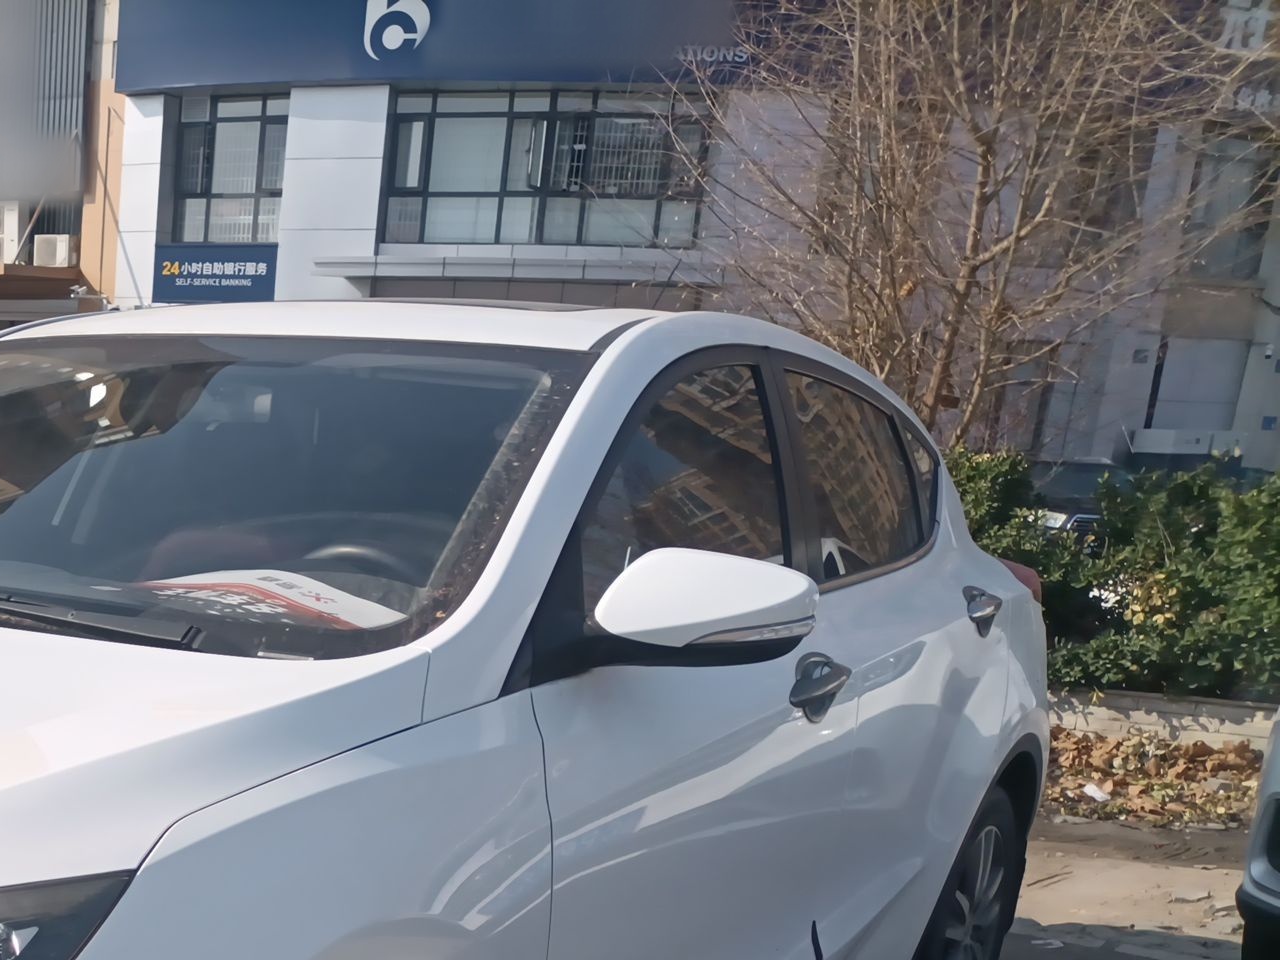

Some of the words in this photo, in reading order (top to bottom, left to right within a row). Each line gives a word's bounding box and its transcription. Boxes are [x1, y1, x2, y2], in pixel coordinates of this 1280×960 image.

[162, 261, 267, 275] 24小时自助银行服务
[175, 278, 220, 286] SELF-SERVICE
[221, 278, 252, 286] BANKING
